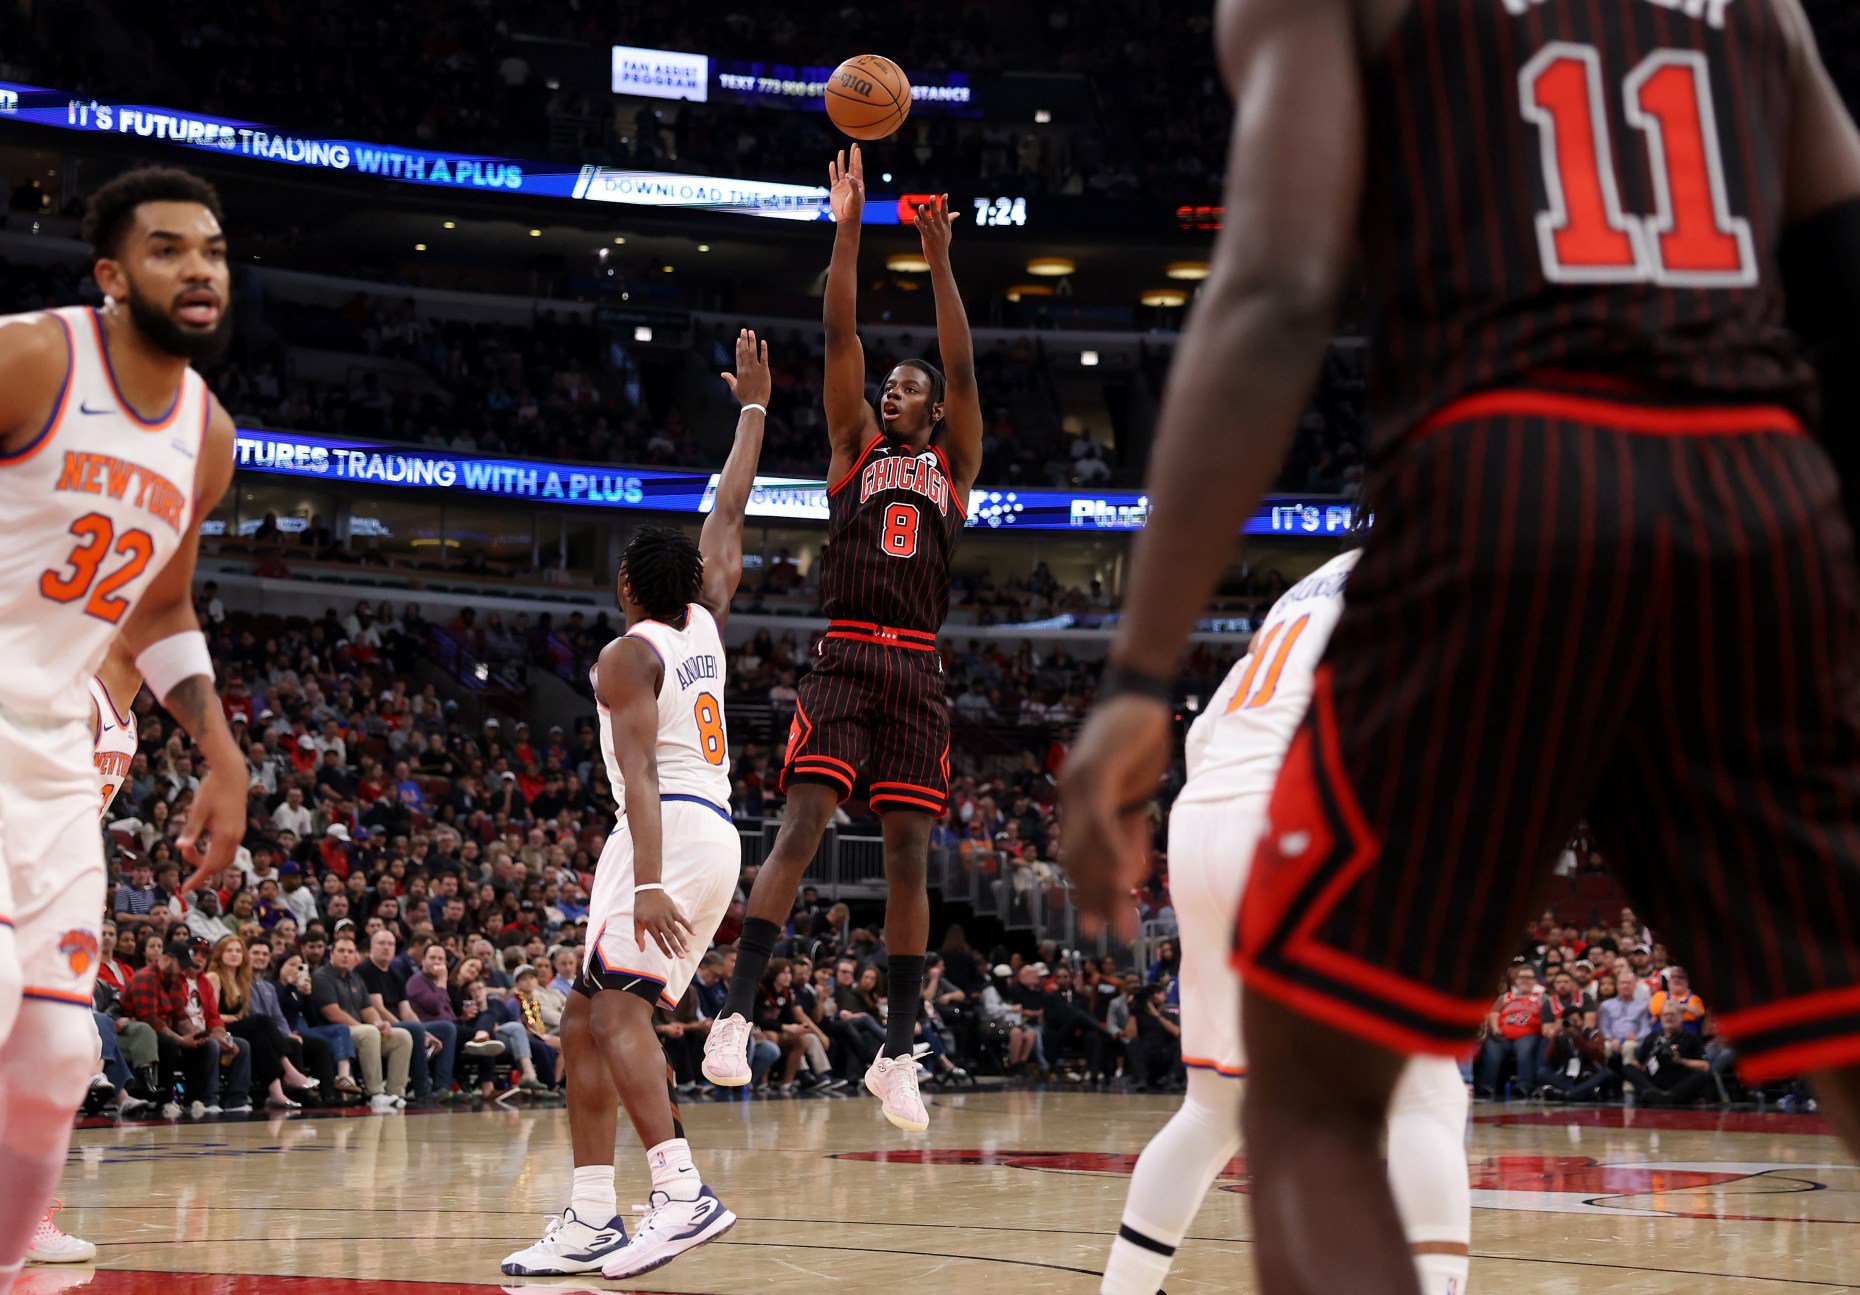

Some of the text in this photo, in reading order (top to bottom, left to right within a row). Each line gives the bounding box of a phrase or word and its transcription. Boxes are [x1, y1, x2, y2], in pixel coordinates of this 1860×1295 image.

[719, 74, 755, 91] TEXT
[911, 85, 970, 102] STANCE
[68, 100, 523, 189] IT'S FUTURES TRADING WITH A PLUS
[1517, 41, 1758, 288] 11
[974, 197, 1026, 226] 7:24
[55, 451, 186, 535] NEW YORK
[232, 438, 329, 473] TURES
[332, 449, 456, 487] TRADING
[461, 461, 538, 496] WITH
[541, 471, 565, 499] A
[568, 473, 644, 504] PLUS
[860, 456, 949, 517] CHICAGO
[881, 502, 920, 558] 8
[1272, 503, 1320, 532] IT'S
[39, 511, 154, 625] 32
[1221, 611, 1312, 717] 11
[694, 691, 726, 766] 8
